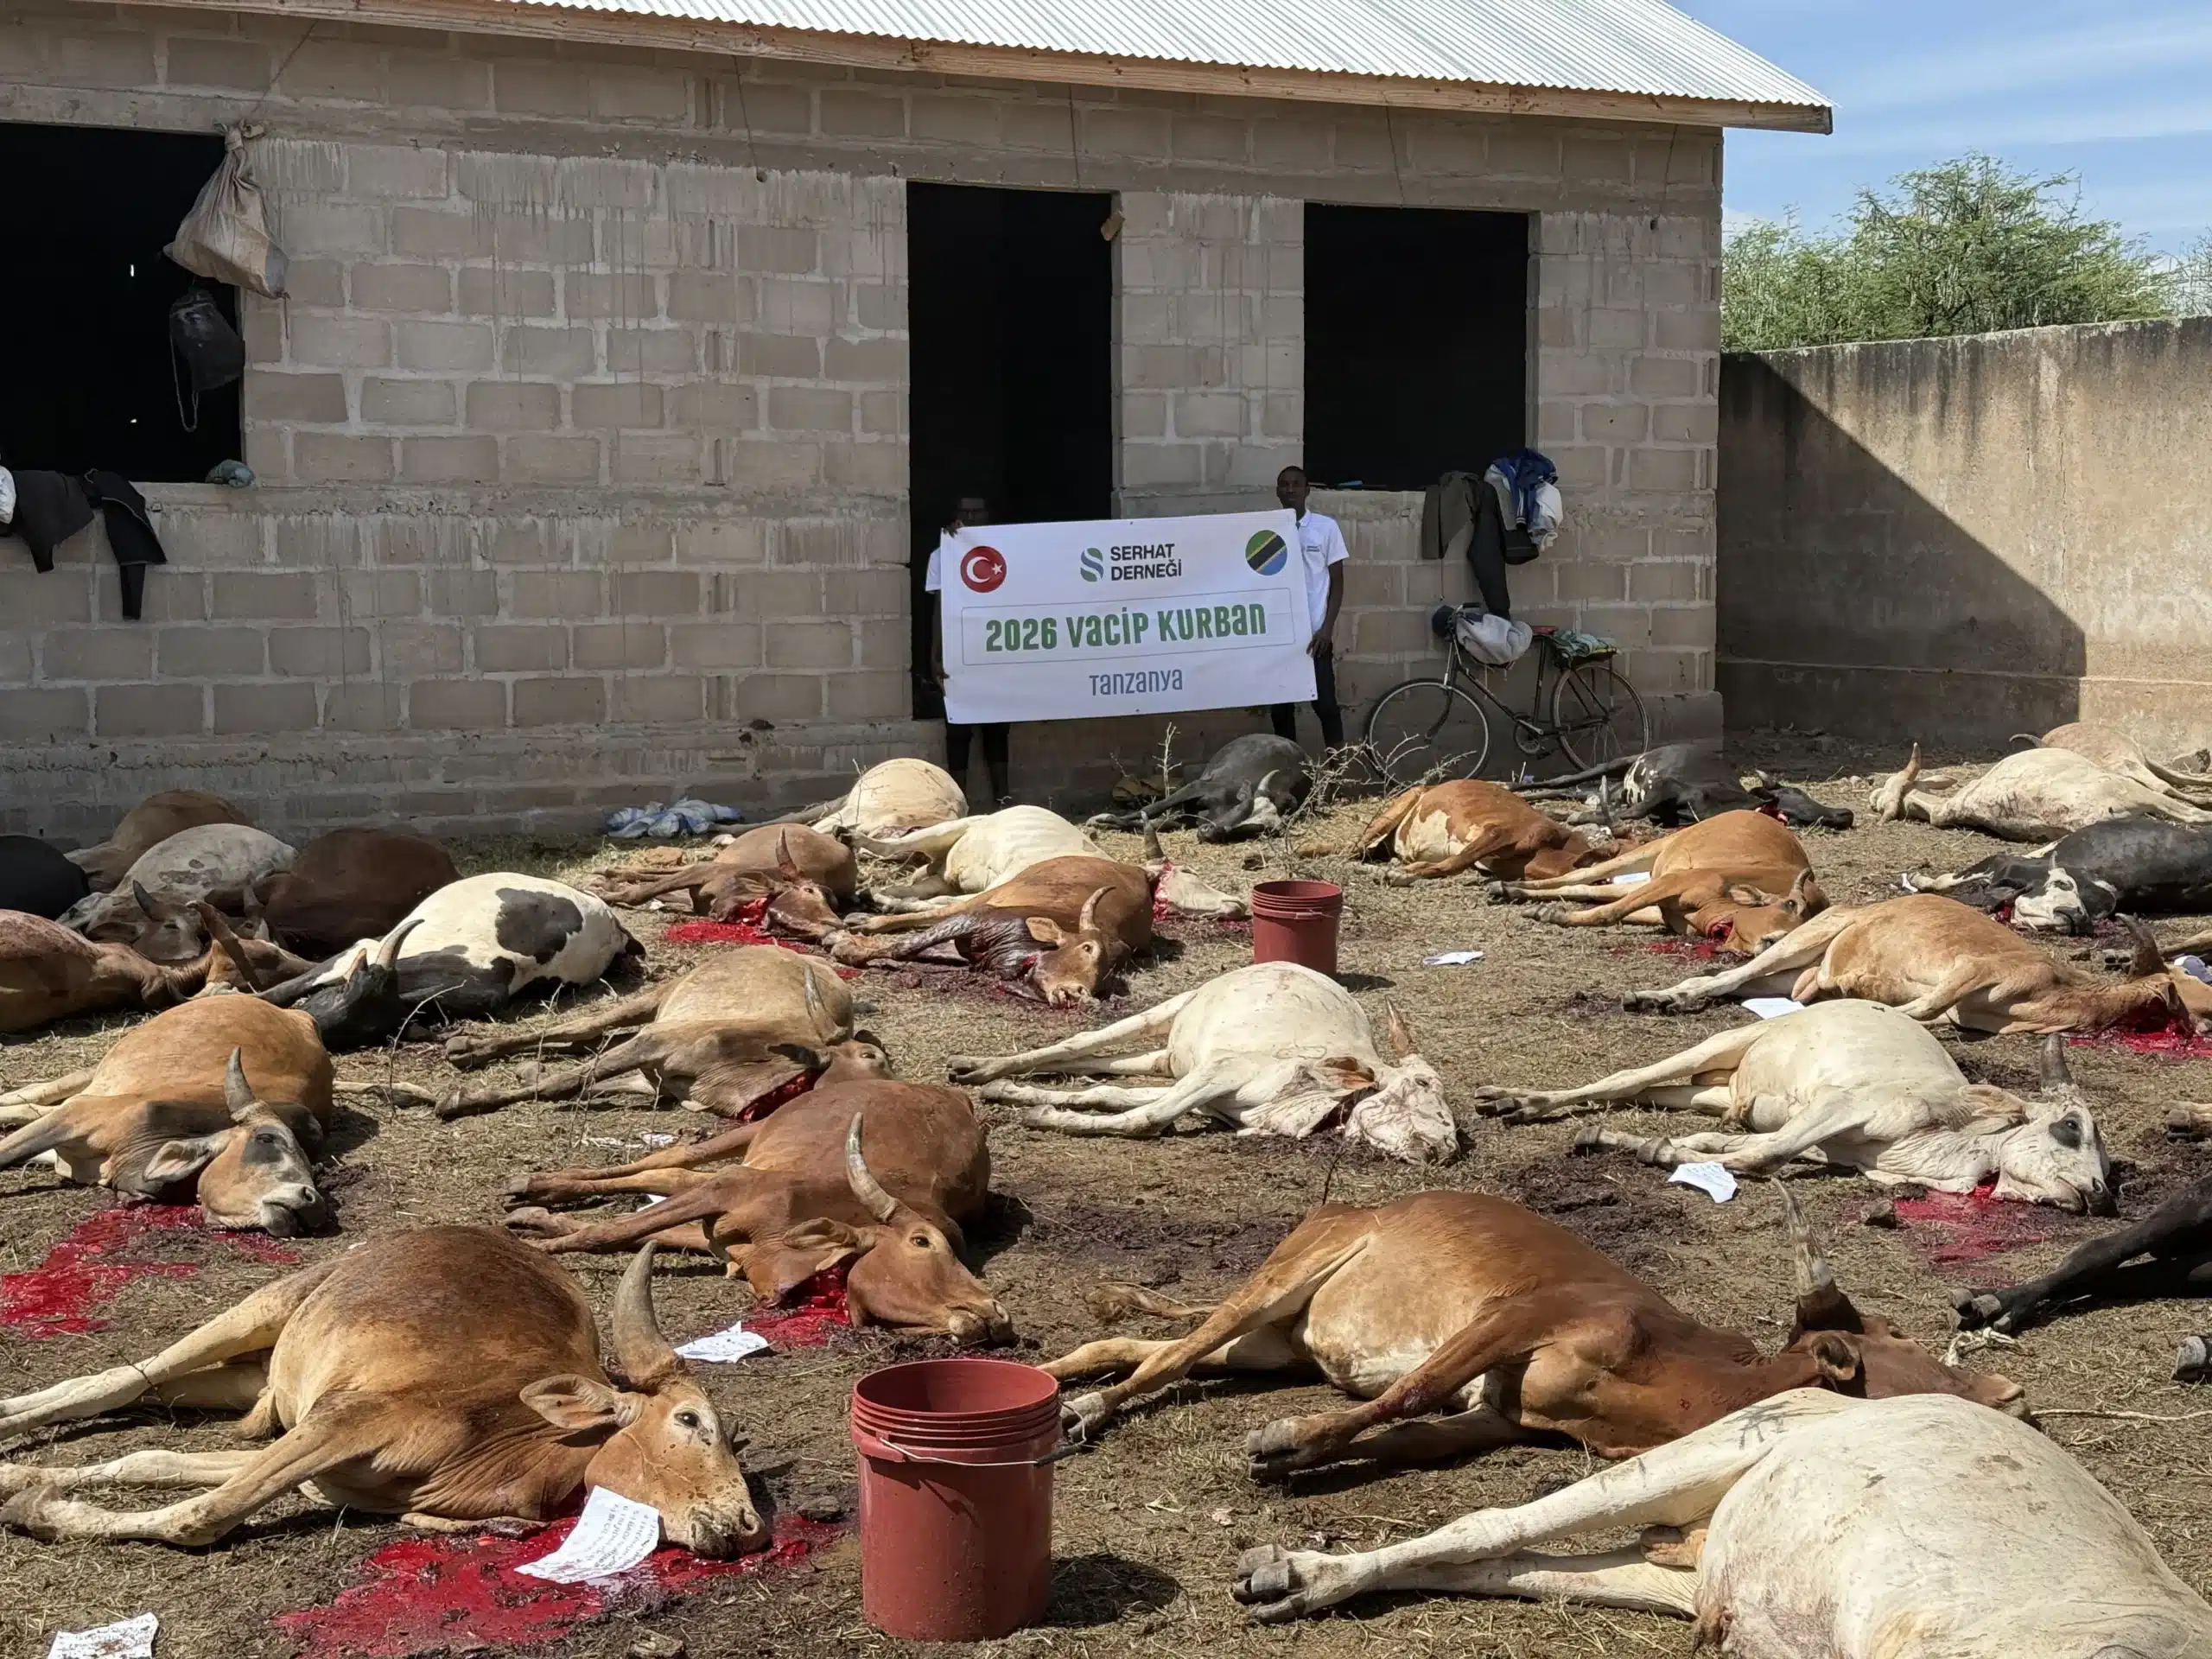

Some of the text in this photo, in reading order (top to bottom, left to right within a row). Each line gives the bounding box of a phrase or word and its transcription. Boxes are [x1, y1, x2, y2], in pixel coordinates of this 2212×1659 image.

[1110, 543, 1175, 562] SERHAT
[1110, 558, 1182, 581] DERNEĞİ
[986, 618, 1058, 652] 2026
